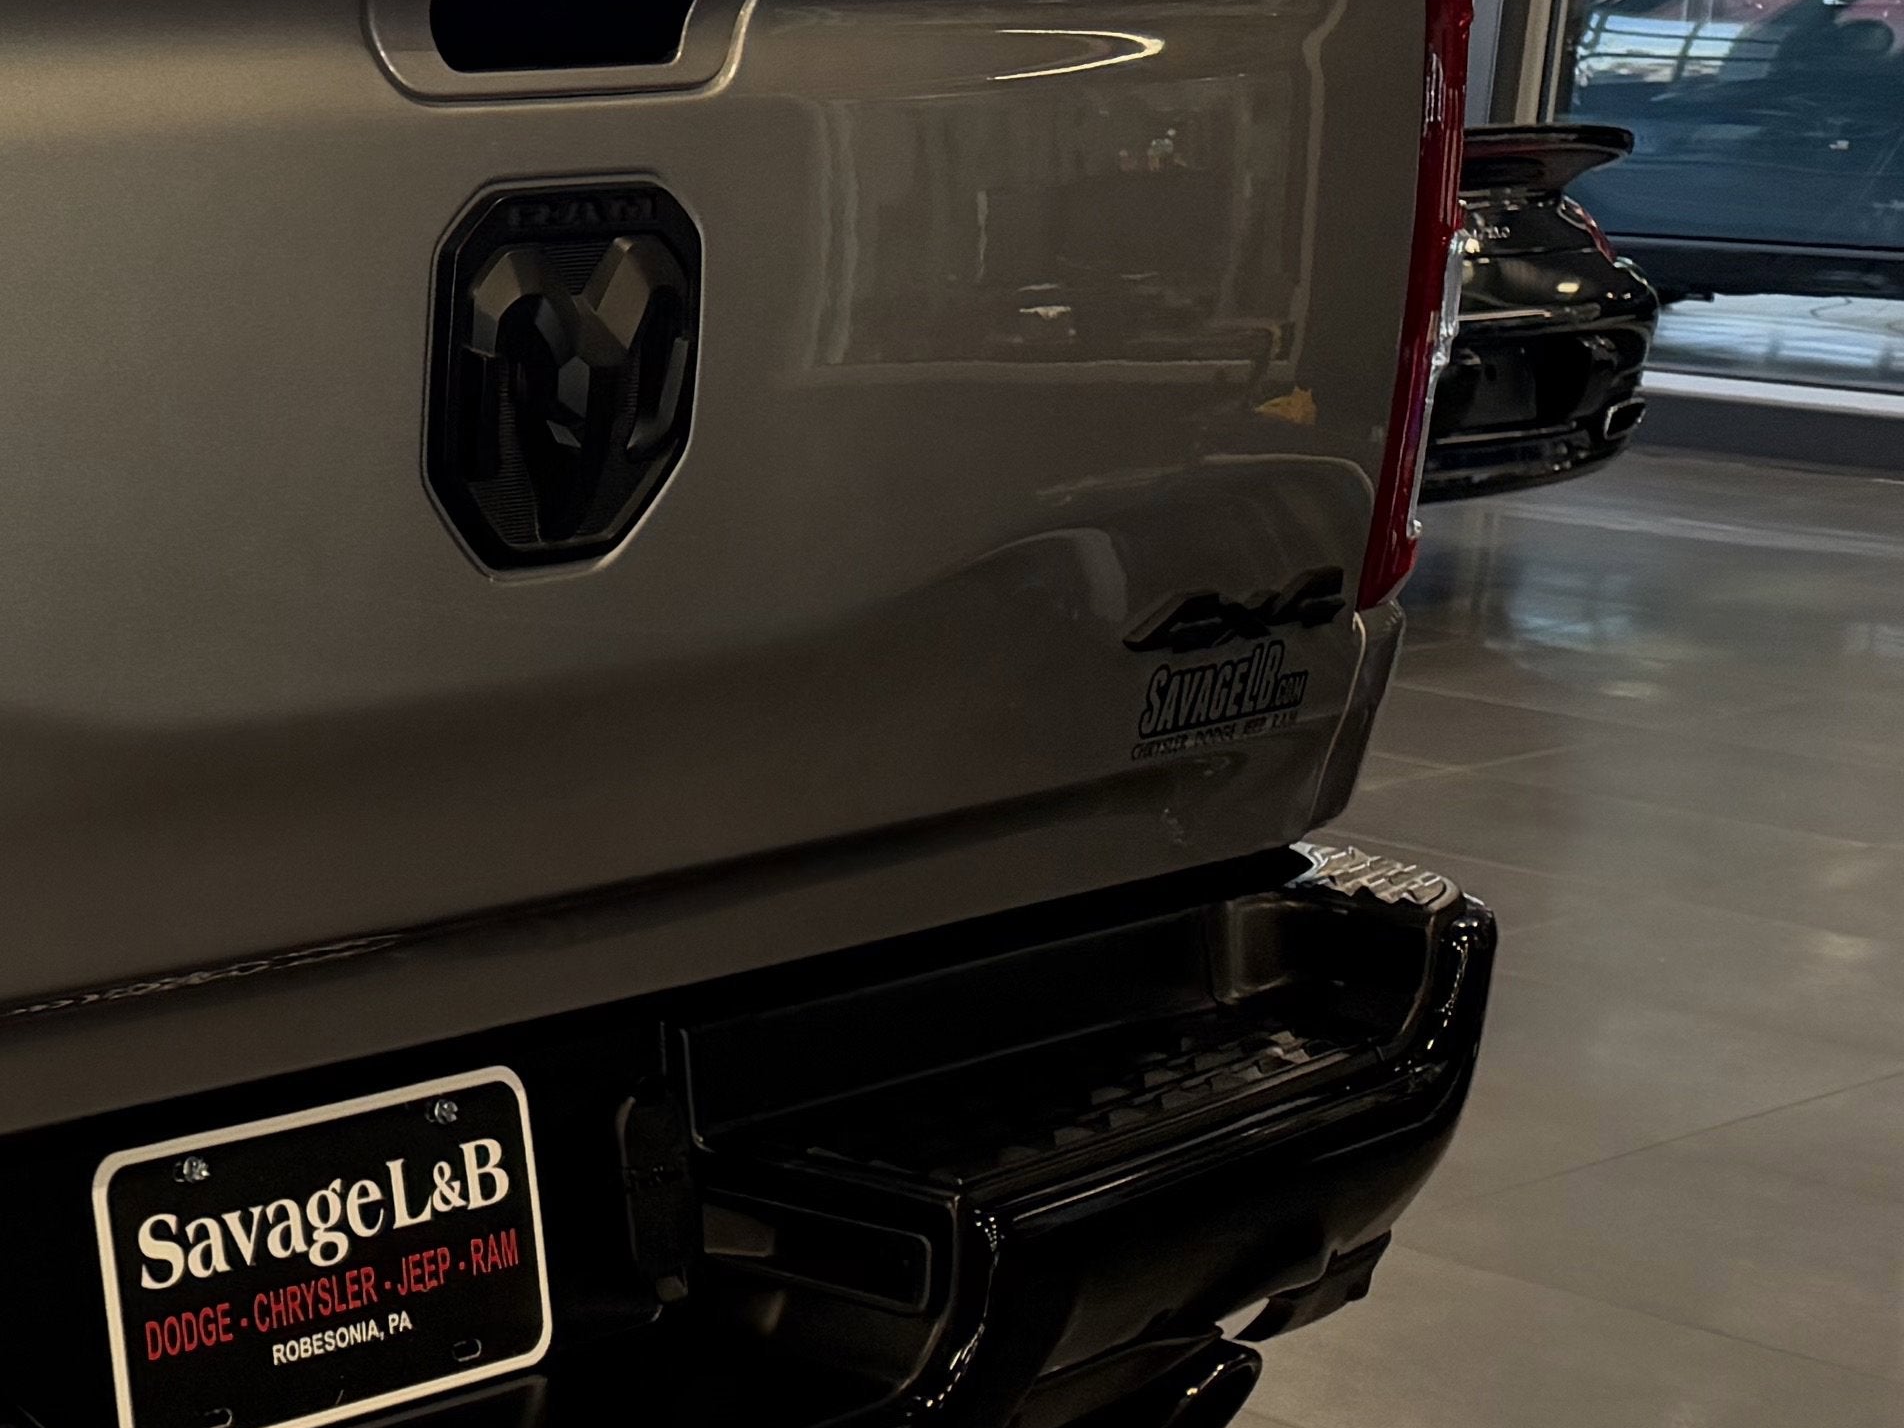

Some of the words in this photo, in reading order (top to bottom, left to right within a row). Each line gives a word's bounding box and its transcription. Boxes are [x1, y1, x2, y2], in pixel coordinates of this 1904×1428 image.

[144, 1302, 234, 1361] DODGE
[253, 1266, 377, 1333] CHRYSLER
[397, 1246, 451, 1297] JEEP
[471, 1228, 520, 1276] RAM
[272, 1318, 386, 1366] ROBESONIA,
[388, 1310, 413, 1335] PA
